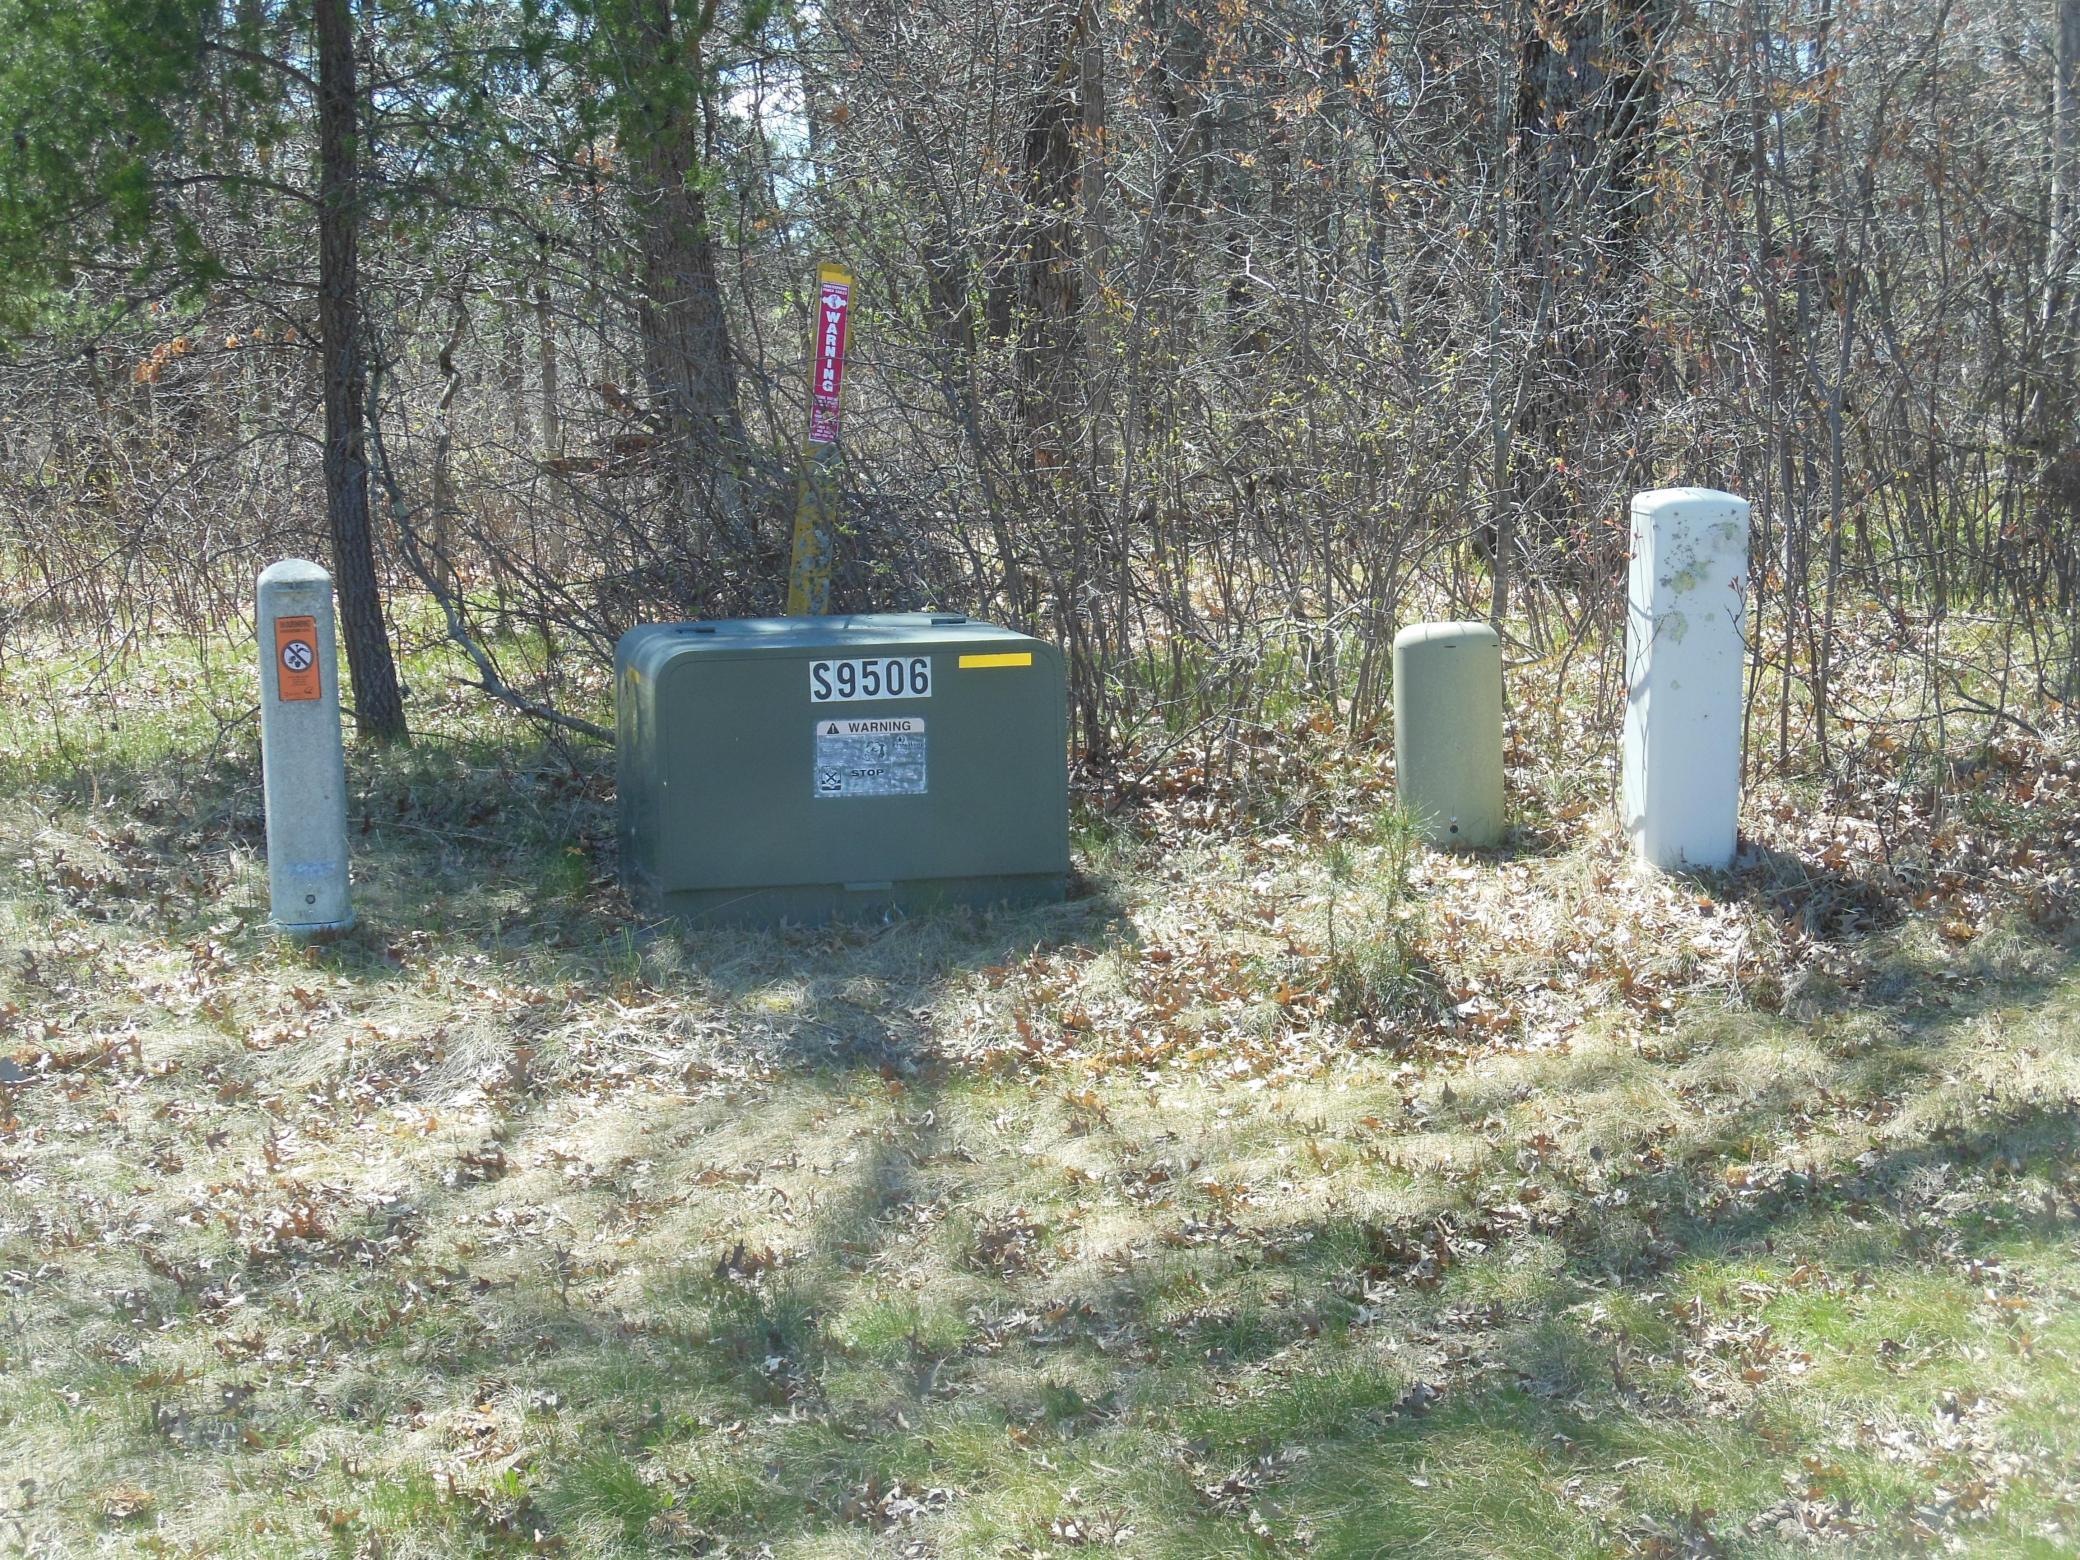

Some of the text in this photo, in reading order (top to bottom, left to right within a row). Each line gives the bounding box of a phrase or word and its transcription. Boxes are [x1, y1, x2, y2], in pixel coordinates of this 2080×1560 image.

[822, 311, 841, 392] WARNING
[812, 658, 929, 700] S9506
[848, 721, 911, 733] WARNING
[851, 769, 884, 777] STOP
